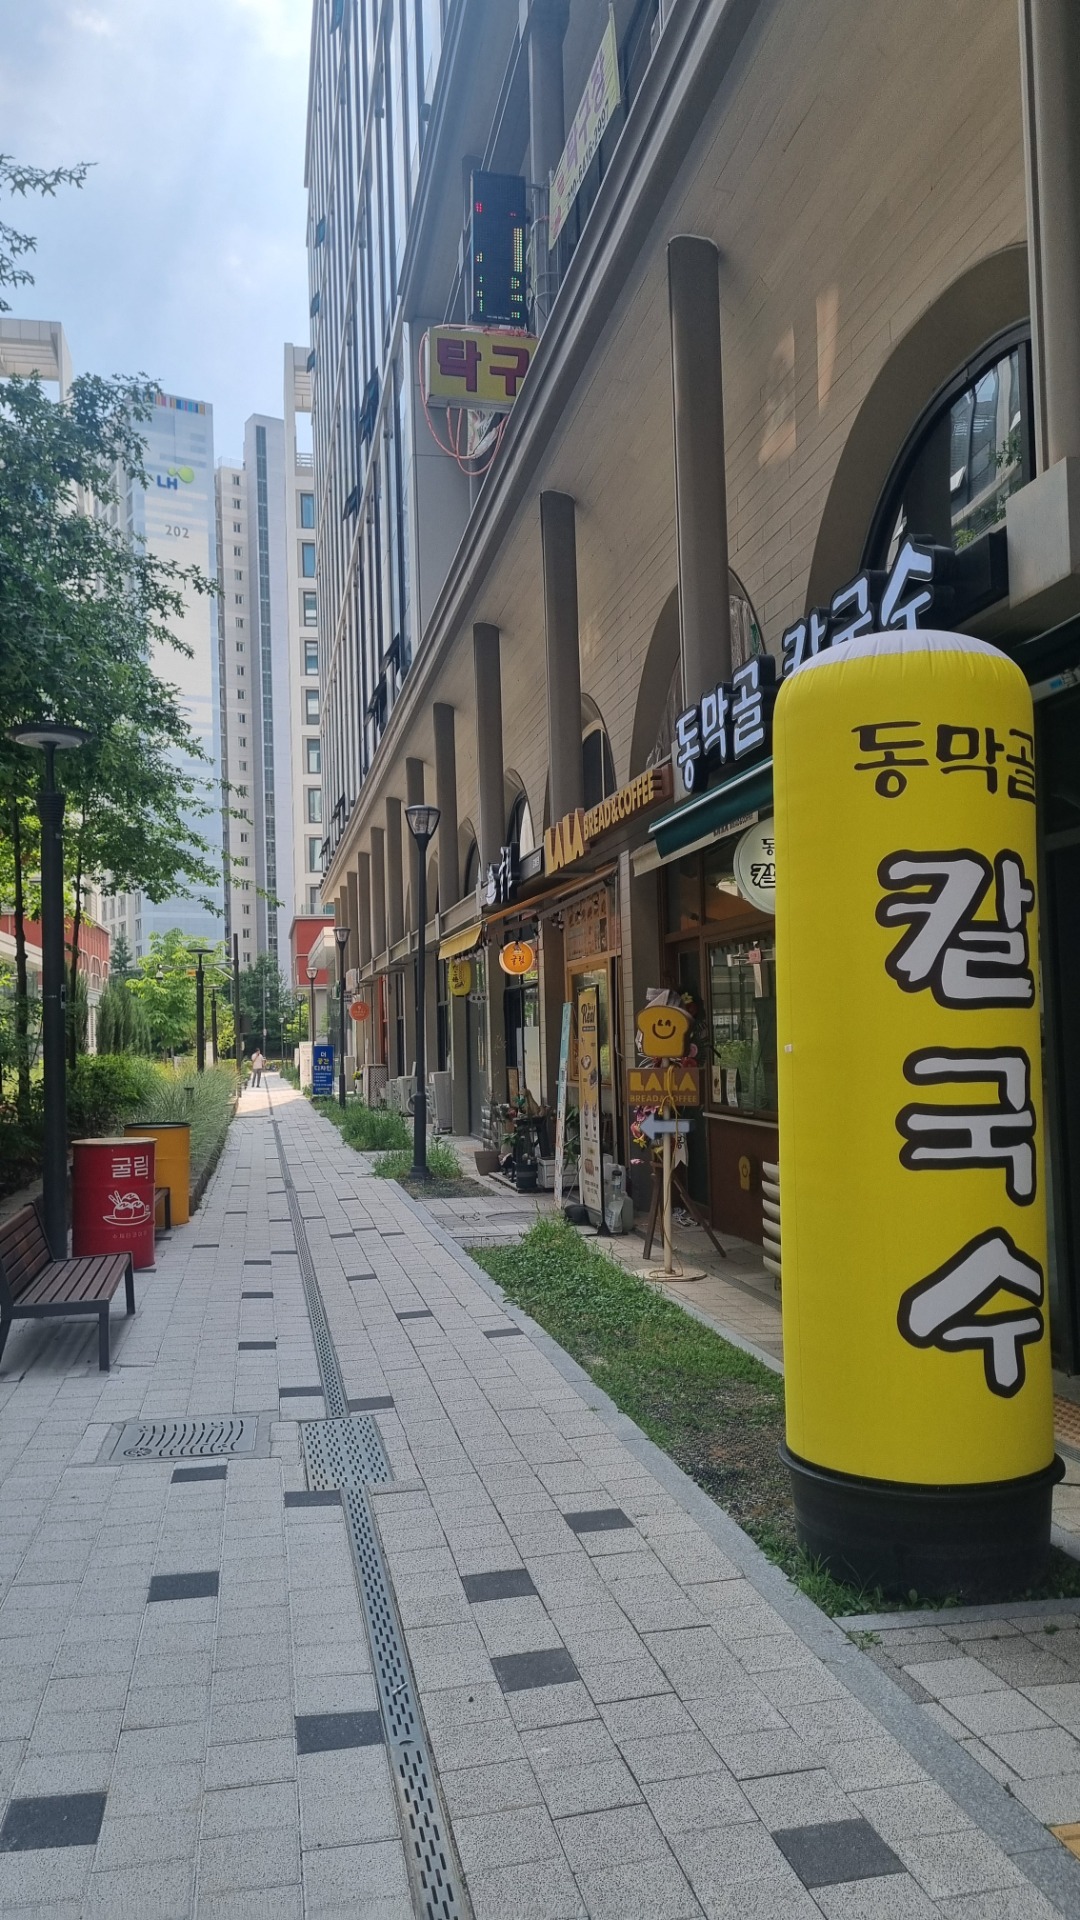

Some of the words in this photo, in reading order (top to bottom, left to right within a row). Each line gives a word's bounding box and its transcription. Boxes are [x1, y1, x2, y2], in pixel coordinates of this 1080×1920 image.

[157, 475, 178, 490] LH
[165, 524, 190, 539] 202
[676, 658, 766, 790] 동막골
[851, 721, 1036, 805] 동막골
[545, 808, 585, 877] LALA
[583, 769, 654, 841] BREAD&COFFEE
[630, 1071, 697, 1091] LALA
[875, 848, 1044, 1399] 칼국수
